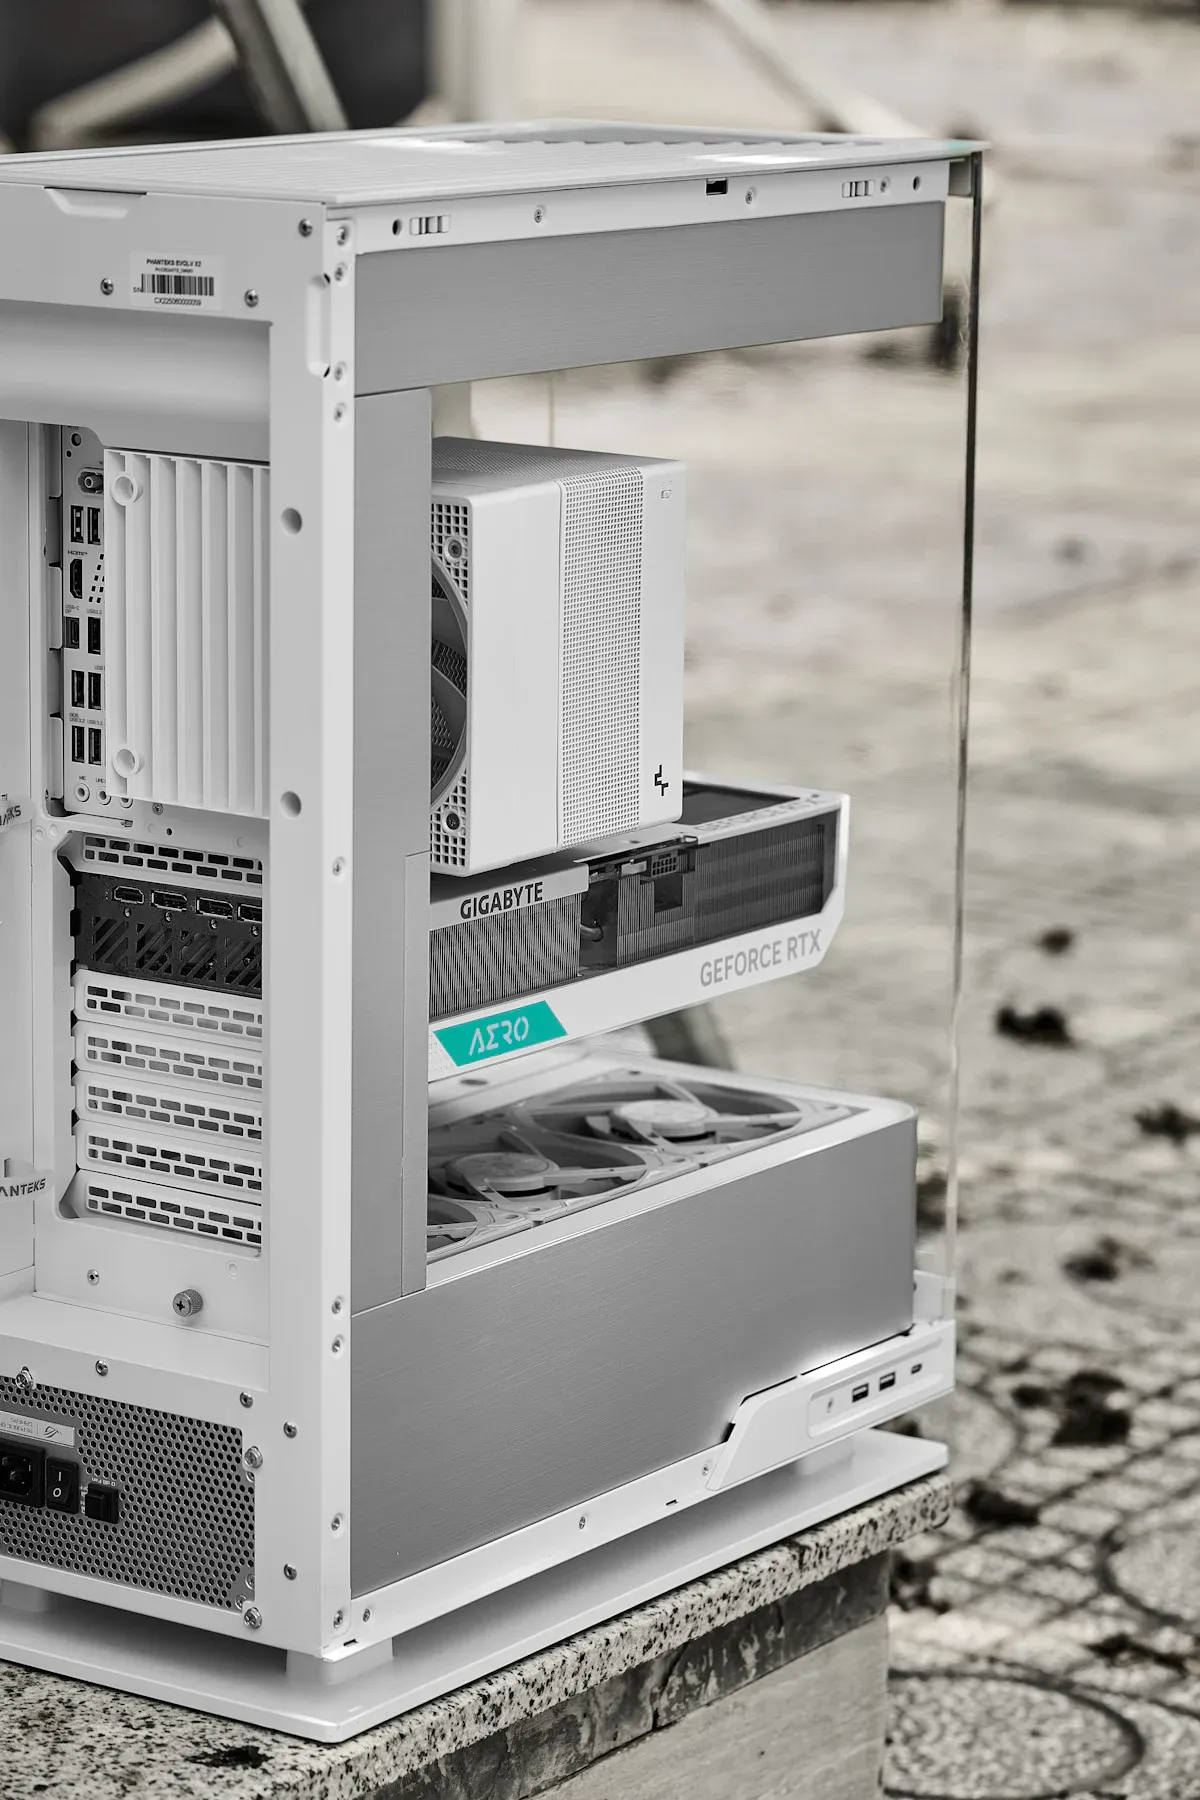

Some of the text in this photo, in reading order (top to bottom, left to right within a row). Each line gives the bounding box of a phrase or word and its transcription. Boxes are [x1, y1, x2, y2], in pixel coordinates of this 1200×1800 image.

[460, 881, 543, 920] GIGABYTE
[700, 928, 821, 987] GEFORCE RTX
[468, 1016, 529, 1056] AERO
